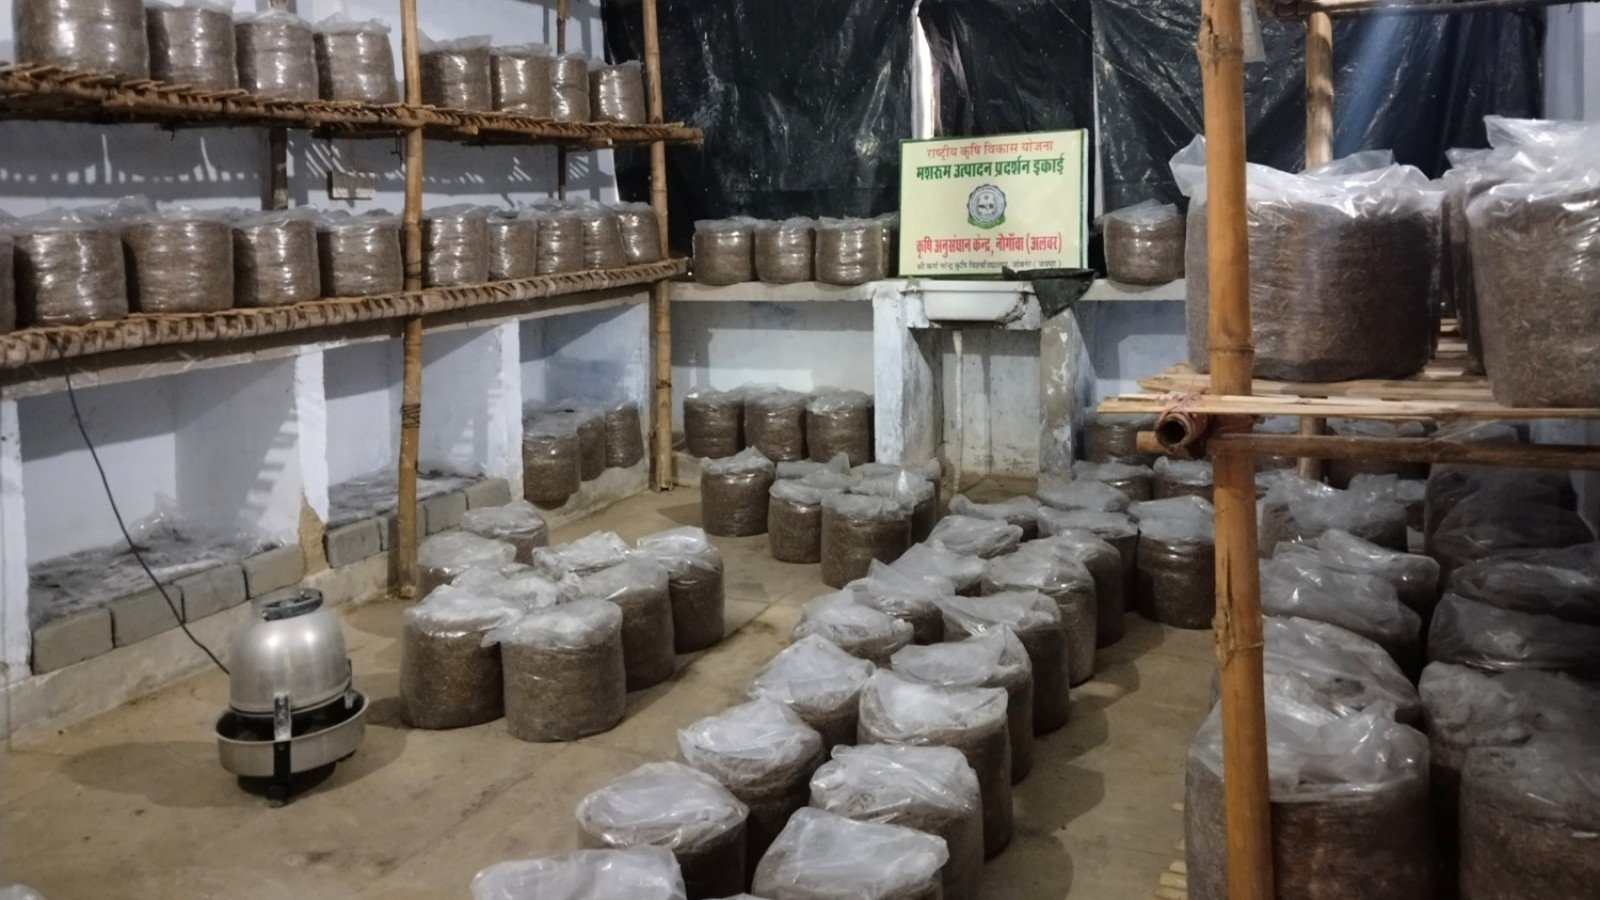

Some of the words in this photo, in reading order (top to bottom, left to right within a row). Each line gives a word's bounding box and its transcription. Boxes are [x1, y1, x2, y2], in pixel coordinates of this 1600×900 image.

[927, 144, 957, 160] राष्ट्रीय
[960, 142, 981, 159] कृषि
[984, 141, 1019, 154] विकास
[1020, 139, 1054, 152] योजना
[916, 165, 952, 180] मशरूम
[953, 161, 993, 178] उत्पादन
[994, 155, 1031, 177] प्रदर्शन
[1033, 153, 1065, 175] इकाई
[916, 236, 933, 259] कृषि
[934, 234, 972, 258] अनुसंधान
[1026, 232, 1062, 254] (अलवर)
